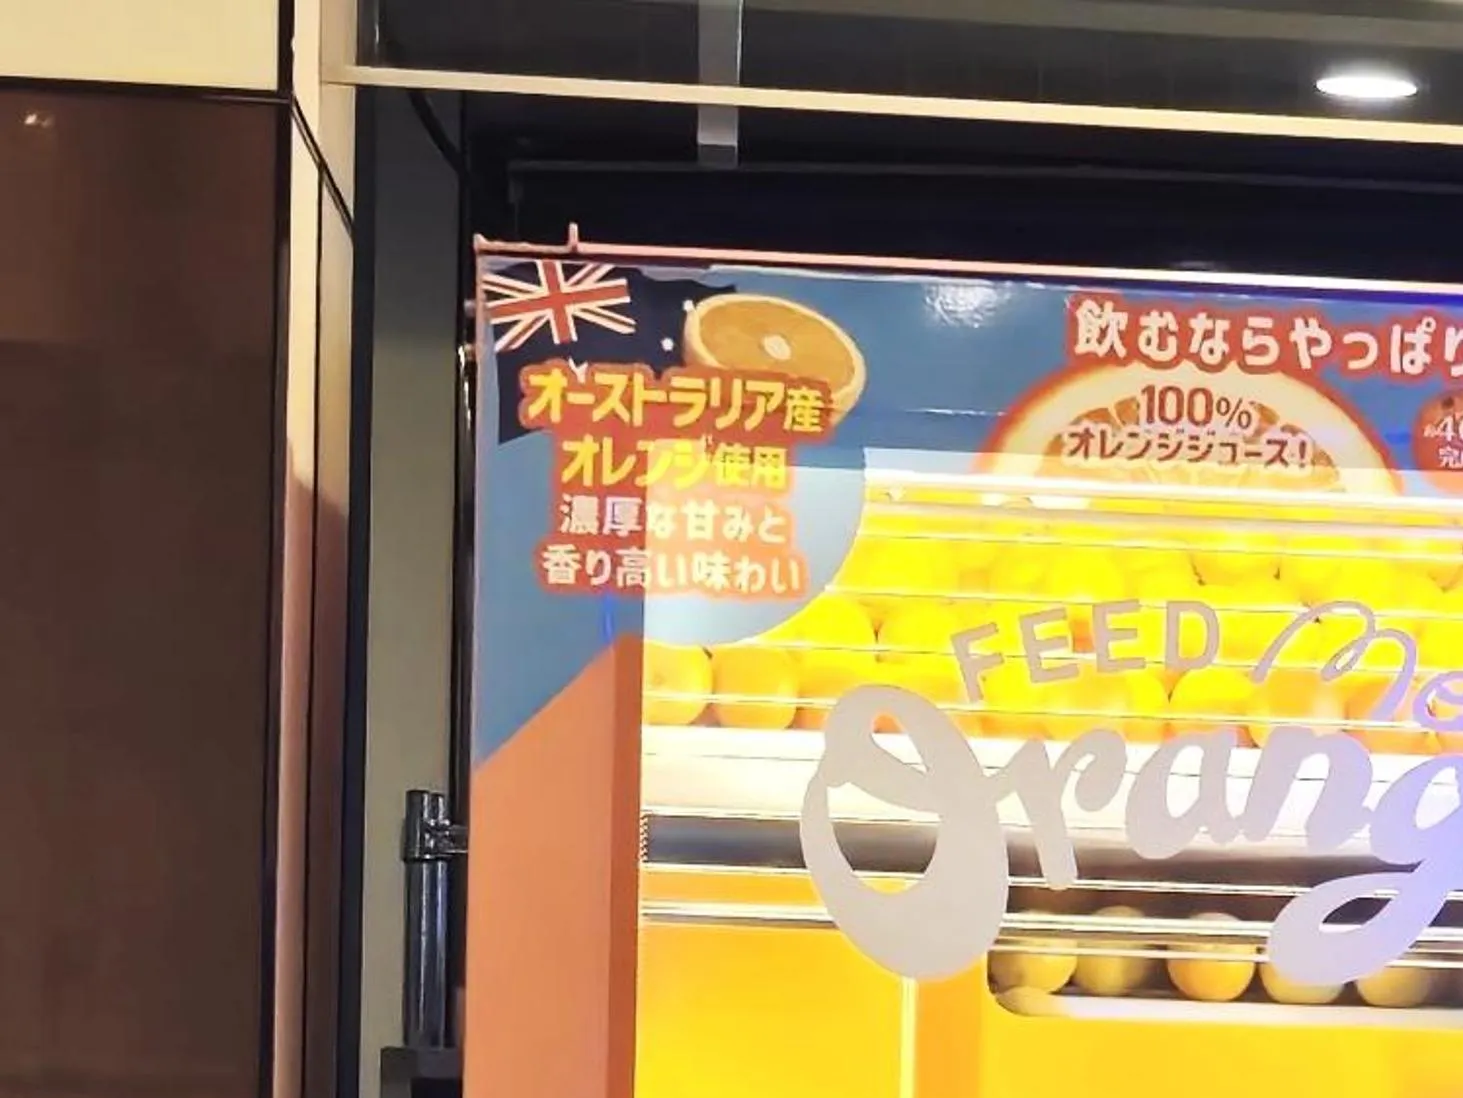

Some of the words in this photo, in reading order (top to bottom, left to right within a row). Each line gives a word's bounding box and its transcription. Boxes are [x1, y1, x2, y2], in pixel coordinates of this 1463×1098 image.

[526, 370, 826, 433] オーストラリア産
[1139, 384, 1254, 430] 100%
[561, 435, 789, 491] オレンジ使用
[1063, 430, 1311, 467] オレンジジュース!
[559, 493, 789, 543] 濃厚な甘みと
[541, 545, 801, 594] 香り高い味わい
[950, 600, 1220, 703] FEED
